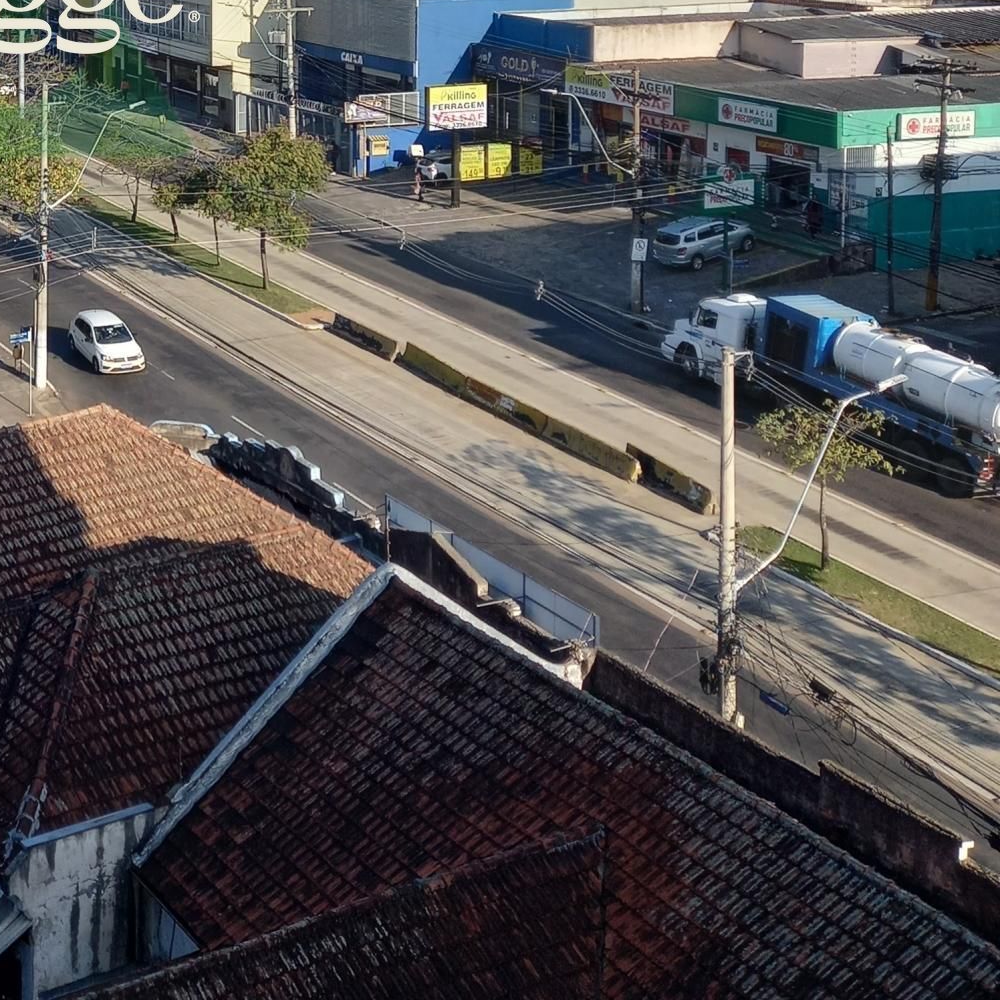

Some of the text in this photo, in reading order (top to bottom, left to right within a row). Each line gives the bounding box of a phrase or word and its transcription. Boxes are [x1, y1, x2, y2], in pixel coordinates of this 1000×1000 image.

[341, 51, 364, 65] CAIXA
[501, 55, 529, 72] GOLD
[610, 75, 672, 96] FERAGEM
[432, 101, 485, 111] FERRAGEM
[630, 110, 690, 133] ALSAF
[923, 115, 971, 125] FARACIA
